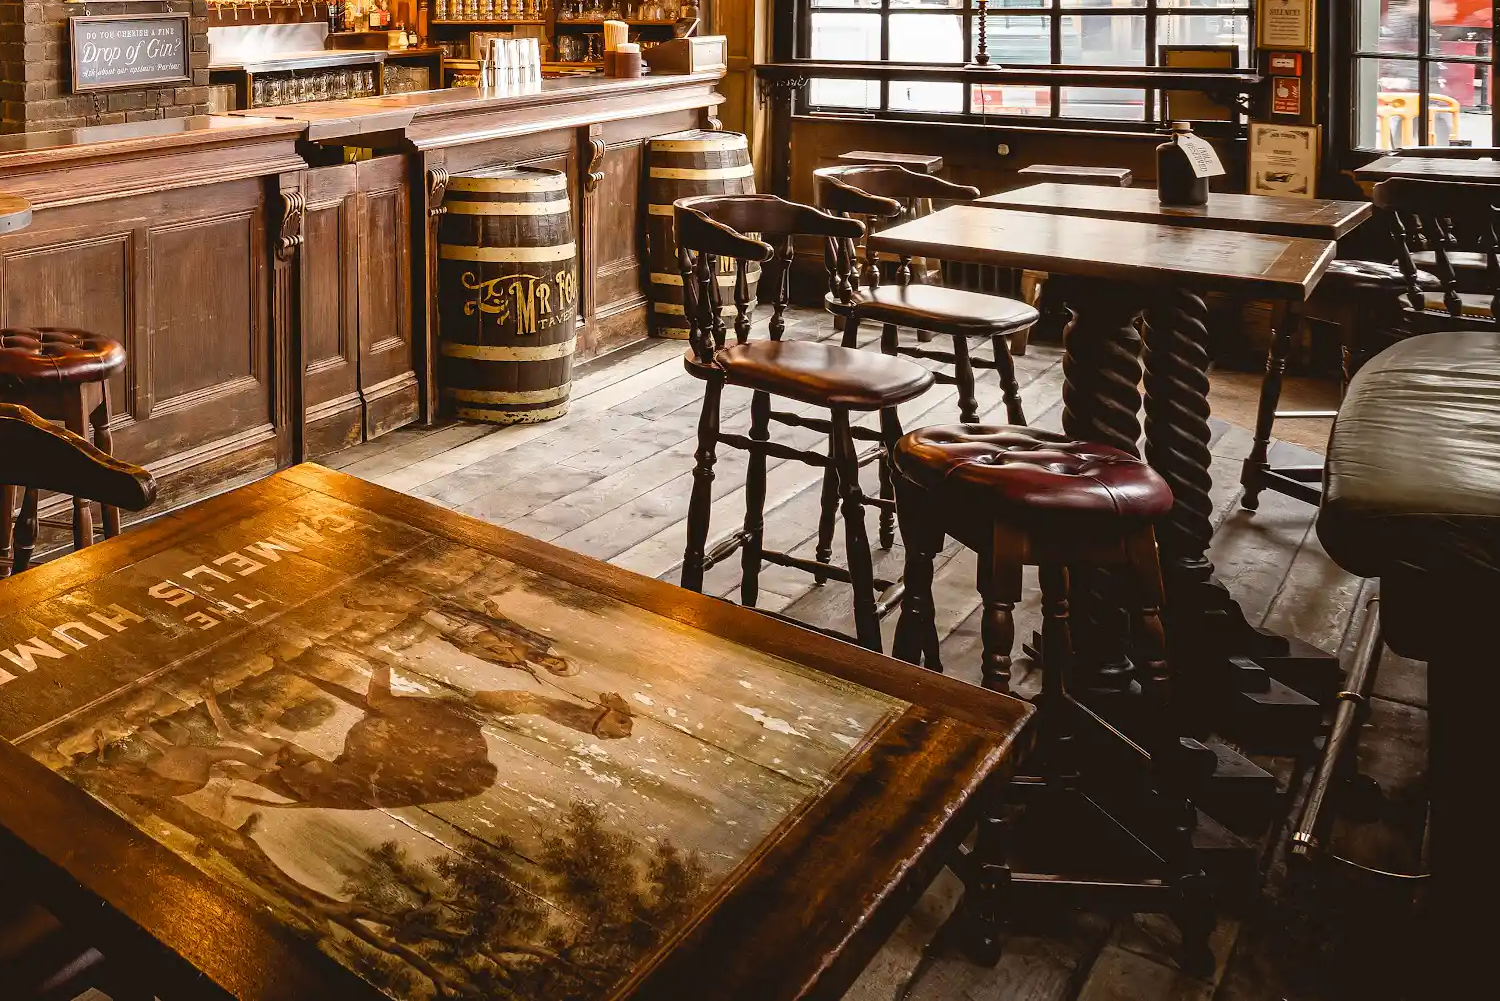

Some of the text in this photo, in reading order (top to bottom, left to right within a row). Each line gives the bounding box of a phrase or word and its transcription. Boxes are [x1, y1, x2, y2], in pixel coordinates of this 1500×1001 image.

[86, 32, 97, 40] DO
[99, 30, 114, 39] YOU
[117, 29, 149, 39] CHERISH
[158, 27, 175, 36] FINE
[82, 37, 181, 67] Drop of Gin?
[508, 278, 552, 335] MR
[181, 592, 265, 632] THE
